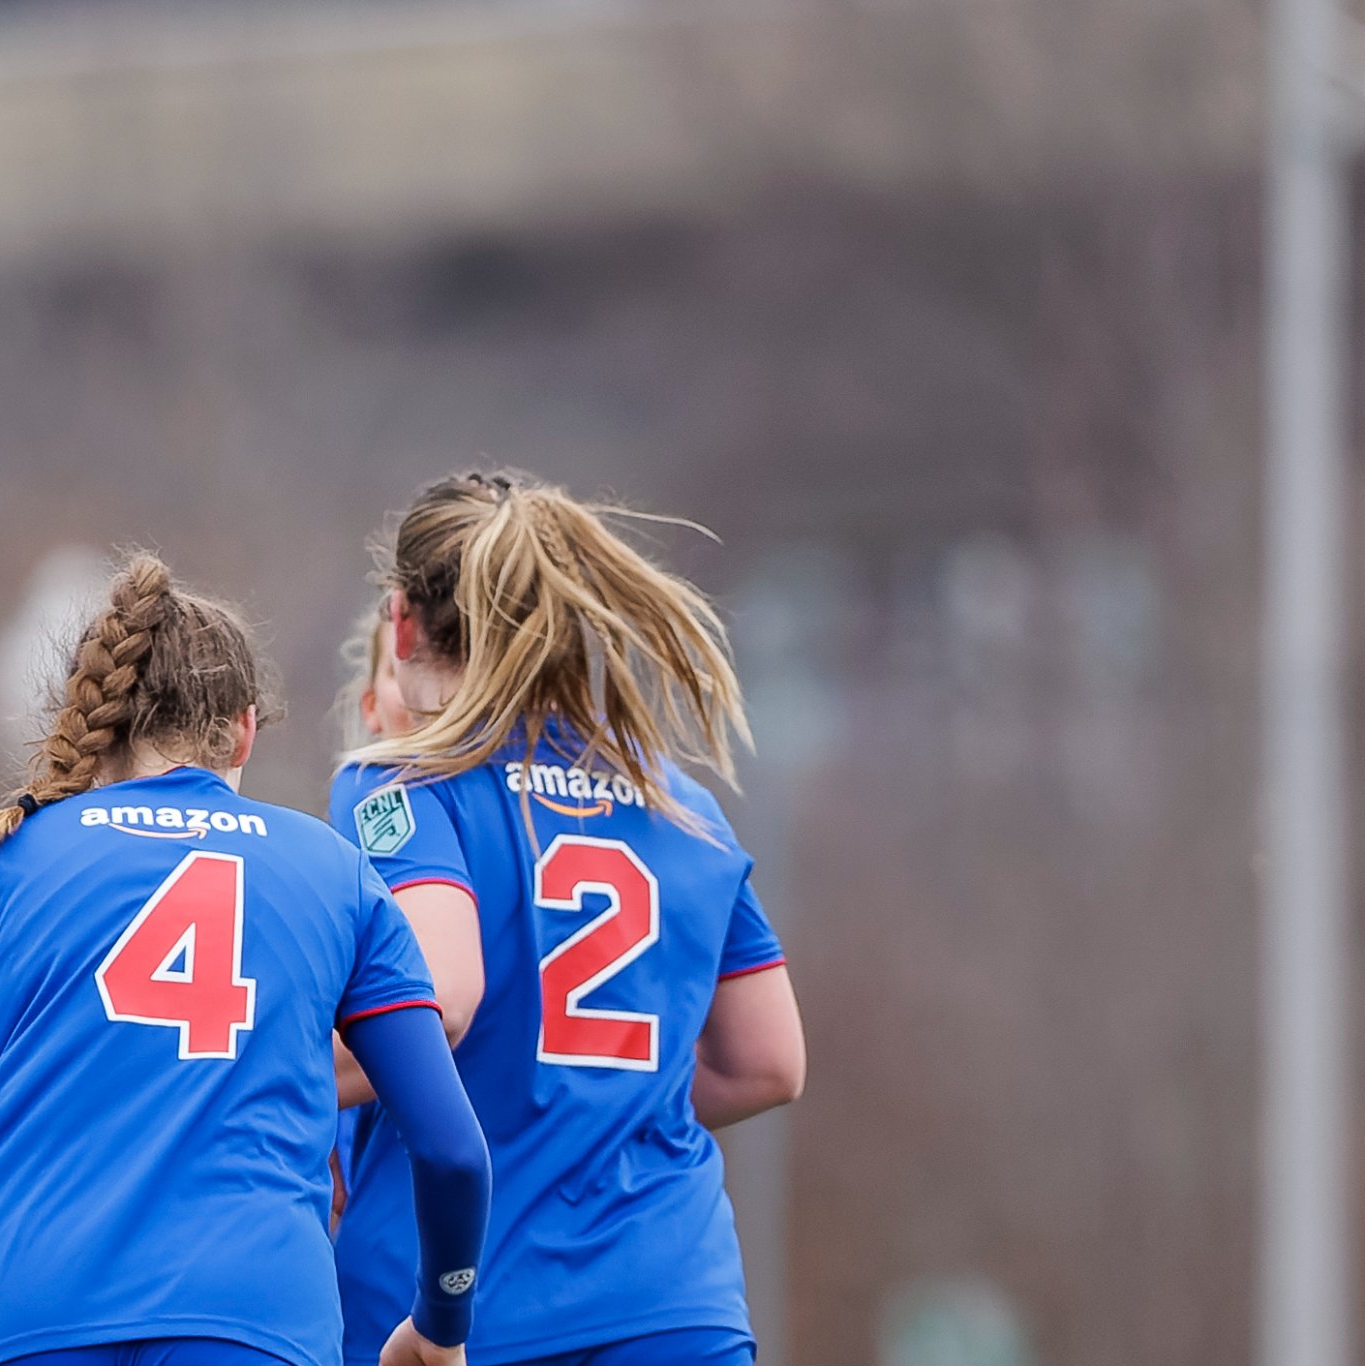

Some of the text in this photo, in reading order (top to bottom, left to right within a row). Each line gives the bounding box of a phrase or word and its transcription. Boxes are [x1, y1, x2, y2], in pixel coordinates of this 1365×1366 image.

[80, 806, 268, 837] amazon
[94, 850, 256, 1061] 4
[533, 834, 659, 1072] 2
